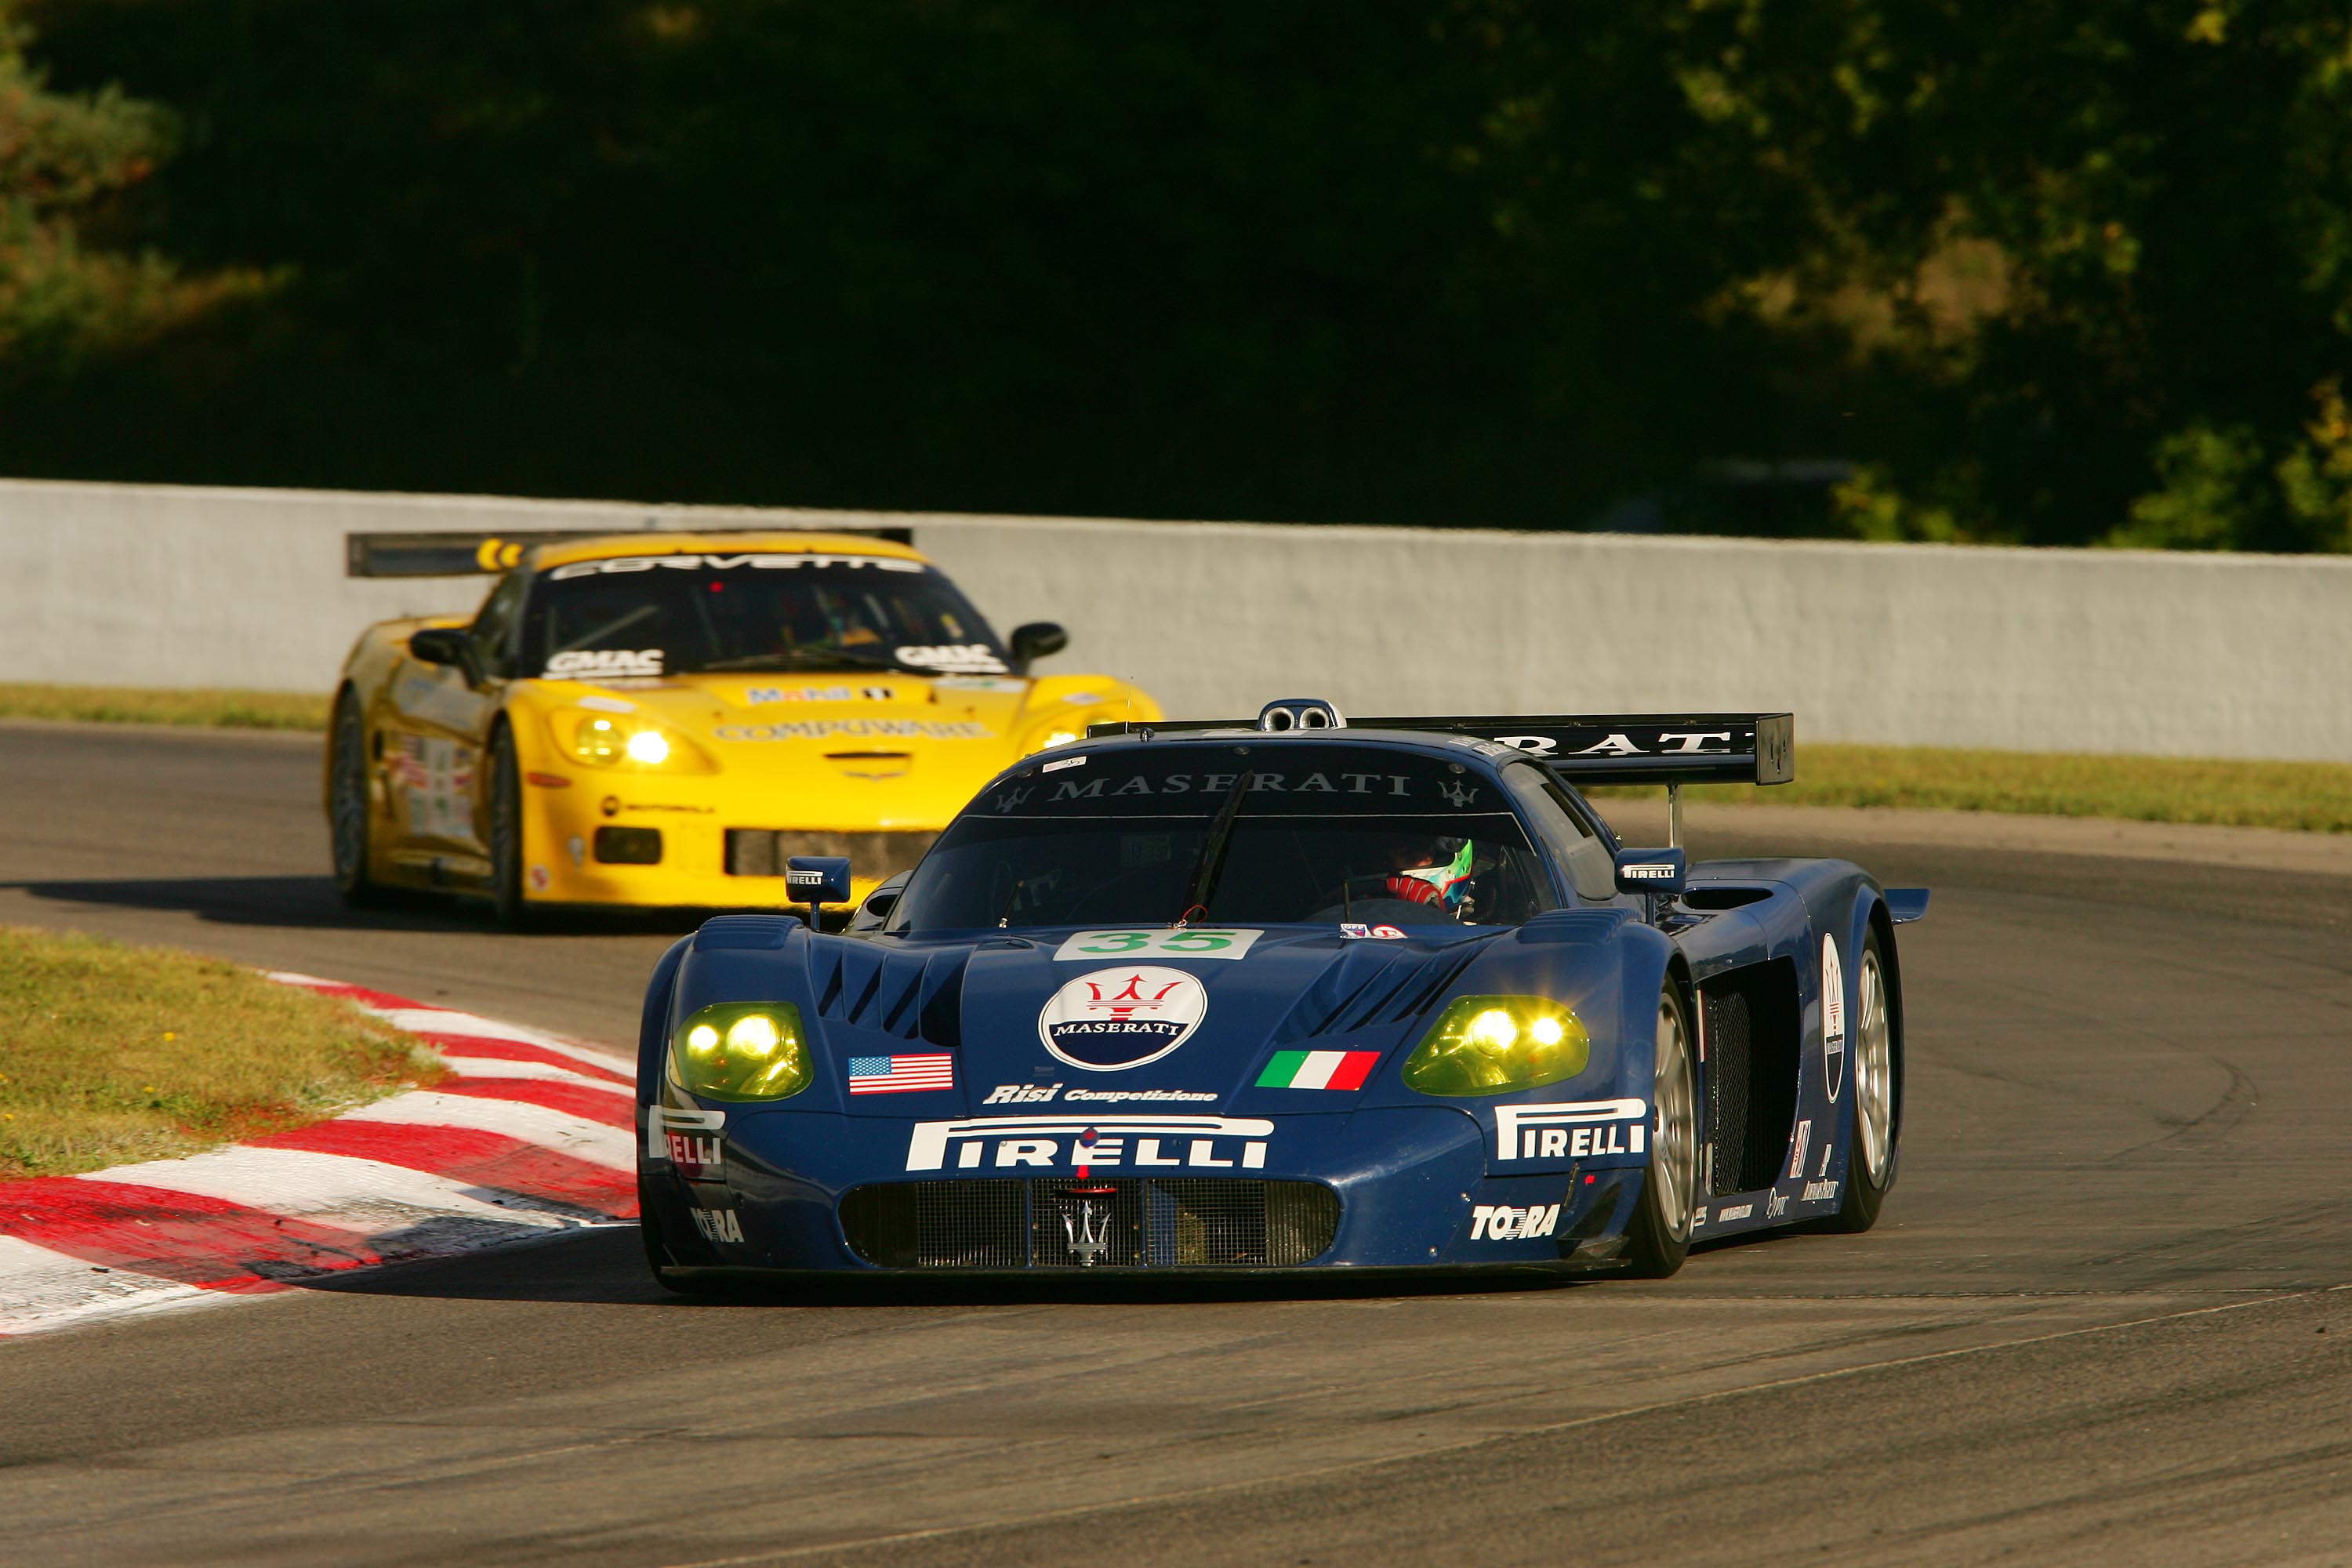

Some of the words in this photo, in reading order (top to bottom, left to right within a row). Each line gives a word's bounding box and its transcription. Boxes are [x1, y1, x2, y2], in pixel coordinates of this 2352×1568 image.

[1047, 772, 1410, 801] MASERATI
[1622, 864, 1675, 879] PIRELLI
[1077, 931, 1237, 953] 35
[1053, 1022, 1180, 1036] MASERATI
[982, 1083, 1063, 1105] Risi
[1064, 1088, 1218, 1103] Competizione
[1494, 1098, 1646, 1160] PIRELLI
[906, 1115, 1276, 1171] PIRELLI
